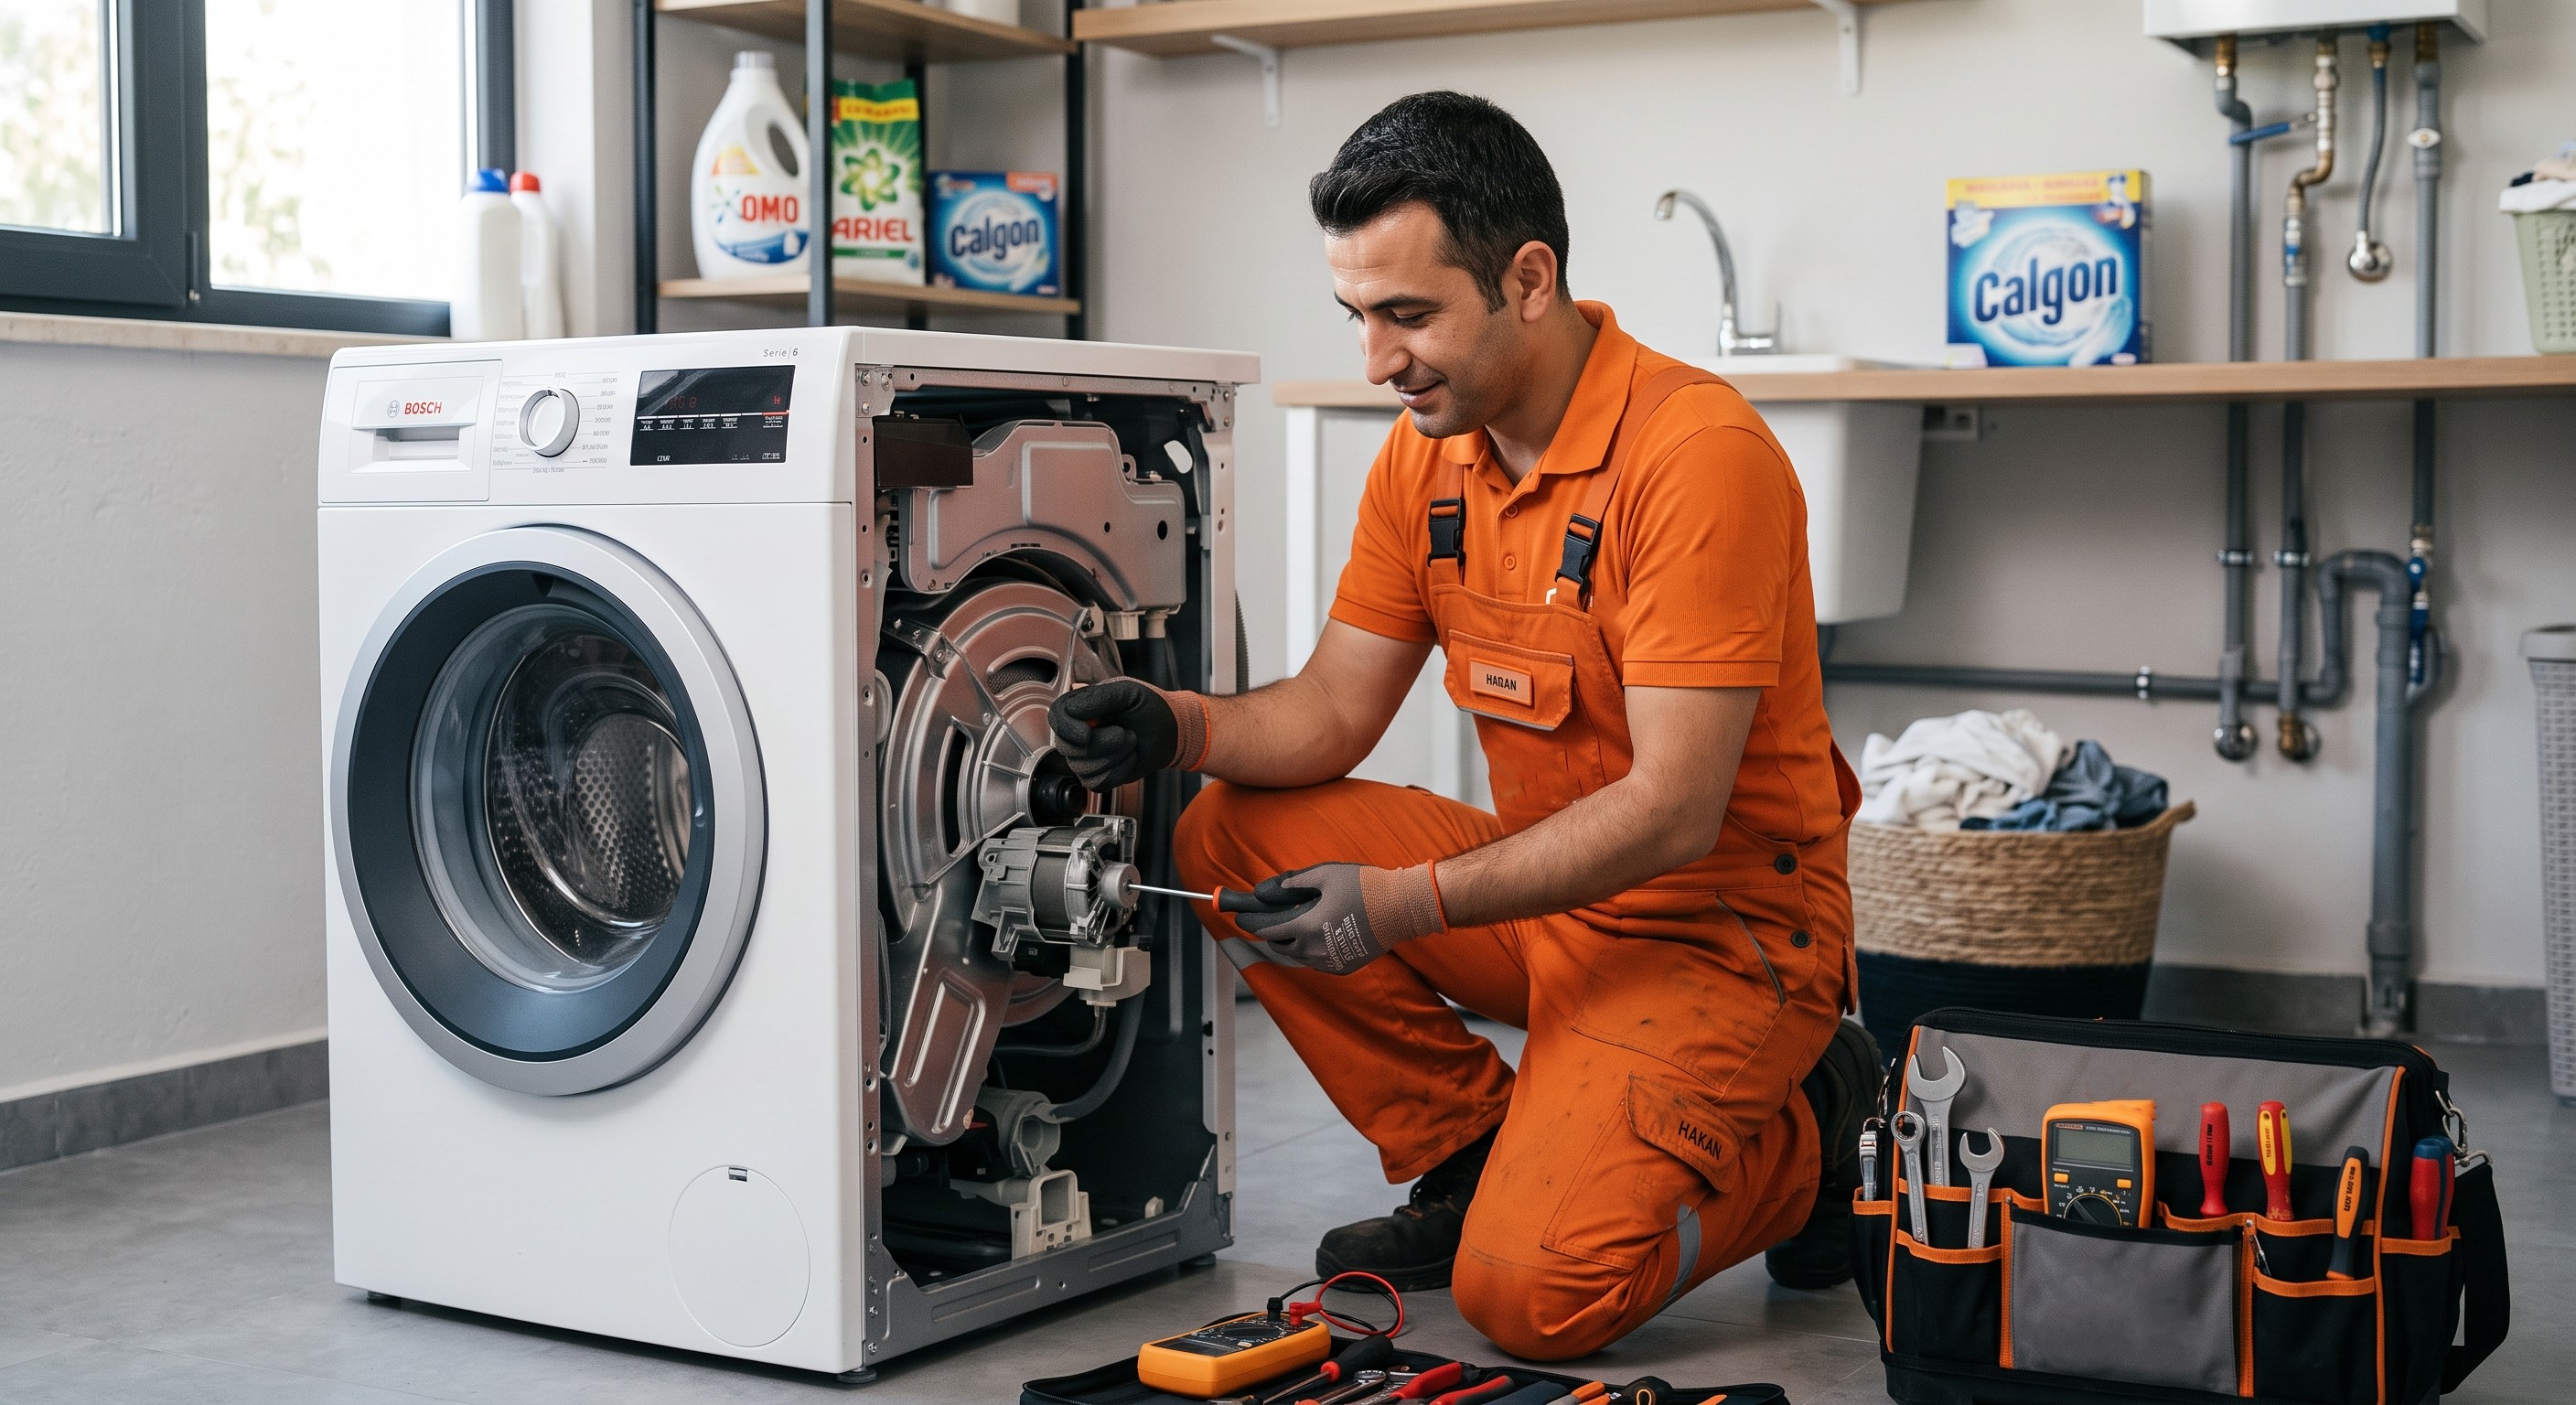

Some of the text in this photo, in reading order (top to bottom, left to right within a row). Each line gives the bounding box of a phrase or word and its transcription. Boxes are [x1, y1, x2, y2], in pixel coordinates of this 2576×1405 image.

[742, 195, 799, 223] OMO
[832, 216, 915, 242] ARIEL
[951, 216, 1039, 261] Calgon
[1974, 256, 2118, 326] Calgon
[404, 402, 443, 415] BOSCH
[1678, 1120, 1723, 1161] HAKAN
